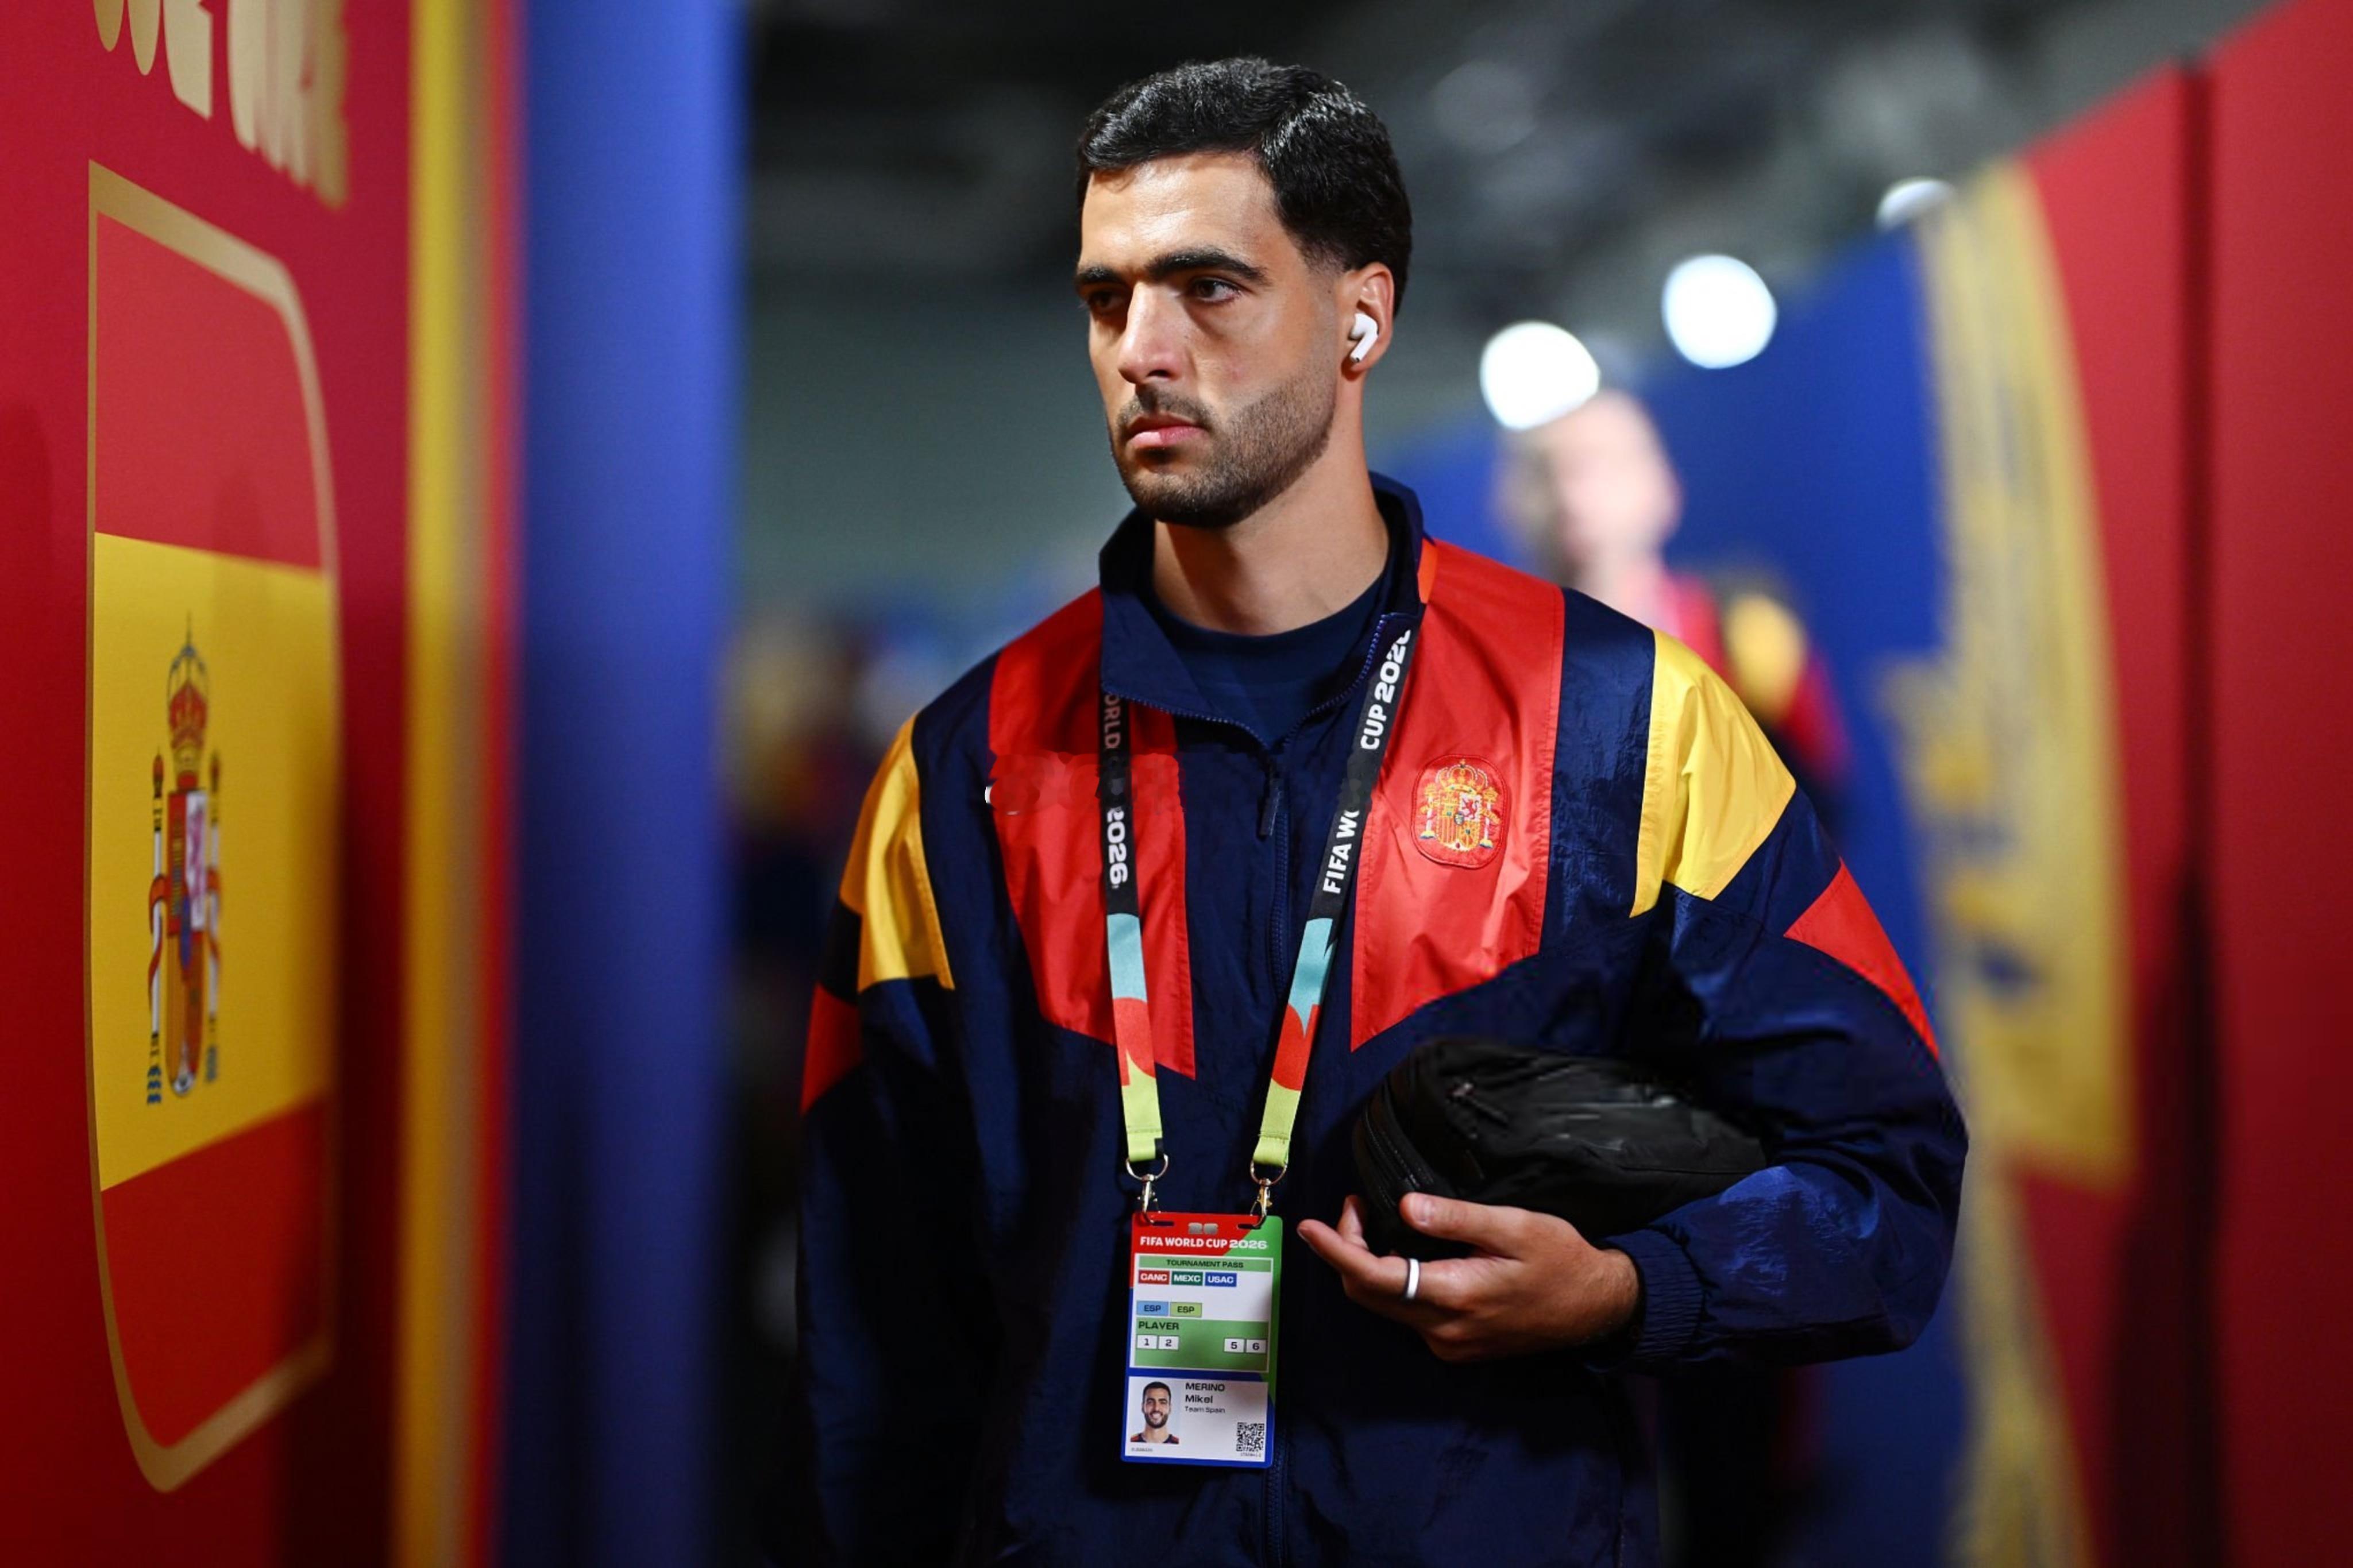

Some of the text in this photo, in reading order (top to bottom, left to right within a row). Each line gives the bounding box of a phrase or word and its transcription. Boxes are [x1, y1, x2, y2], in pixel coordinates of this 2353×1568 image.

[1105, 694, 1121, 749] ORLD
[1360, 704, 1387, 750] CUP
[1107, 806, 1128, 885] 2026
[1322, 844, 1352, 894] FIFA
[1140, 1236, 1268, 1249] FIFA WORLD CUP 2026
[1167, 1259, 1220, 1267] TOURNAMENT
[1140, 1273, 1167, 1281] CANC
[1208, 1276, 1234, 1284] USAC
[1139, 1321, 1179, 1330] PLAYER
[1144, 1338, 1150, 1346] 1
[1166, 1339, 1172, 1347] 2
[1231, 1342, 1237, 1350] 5
[1252, 1343, 1259, 1351] 6
[1186, 1382, 1225, 1392] MERINO
[1185, 1395, 1213, 1403] Mikel
